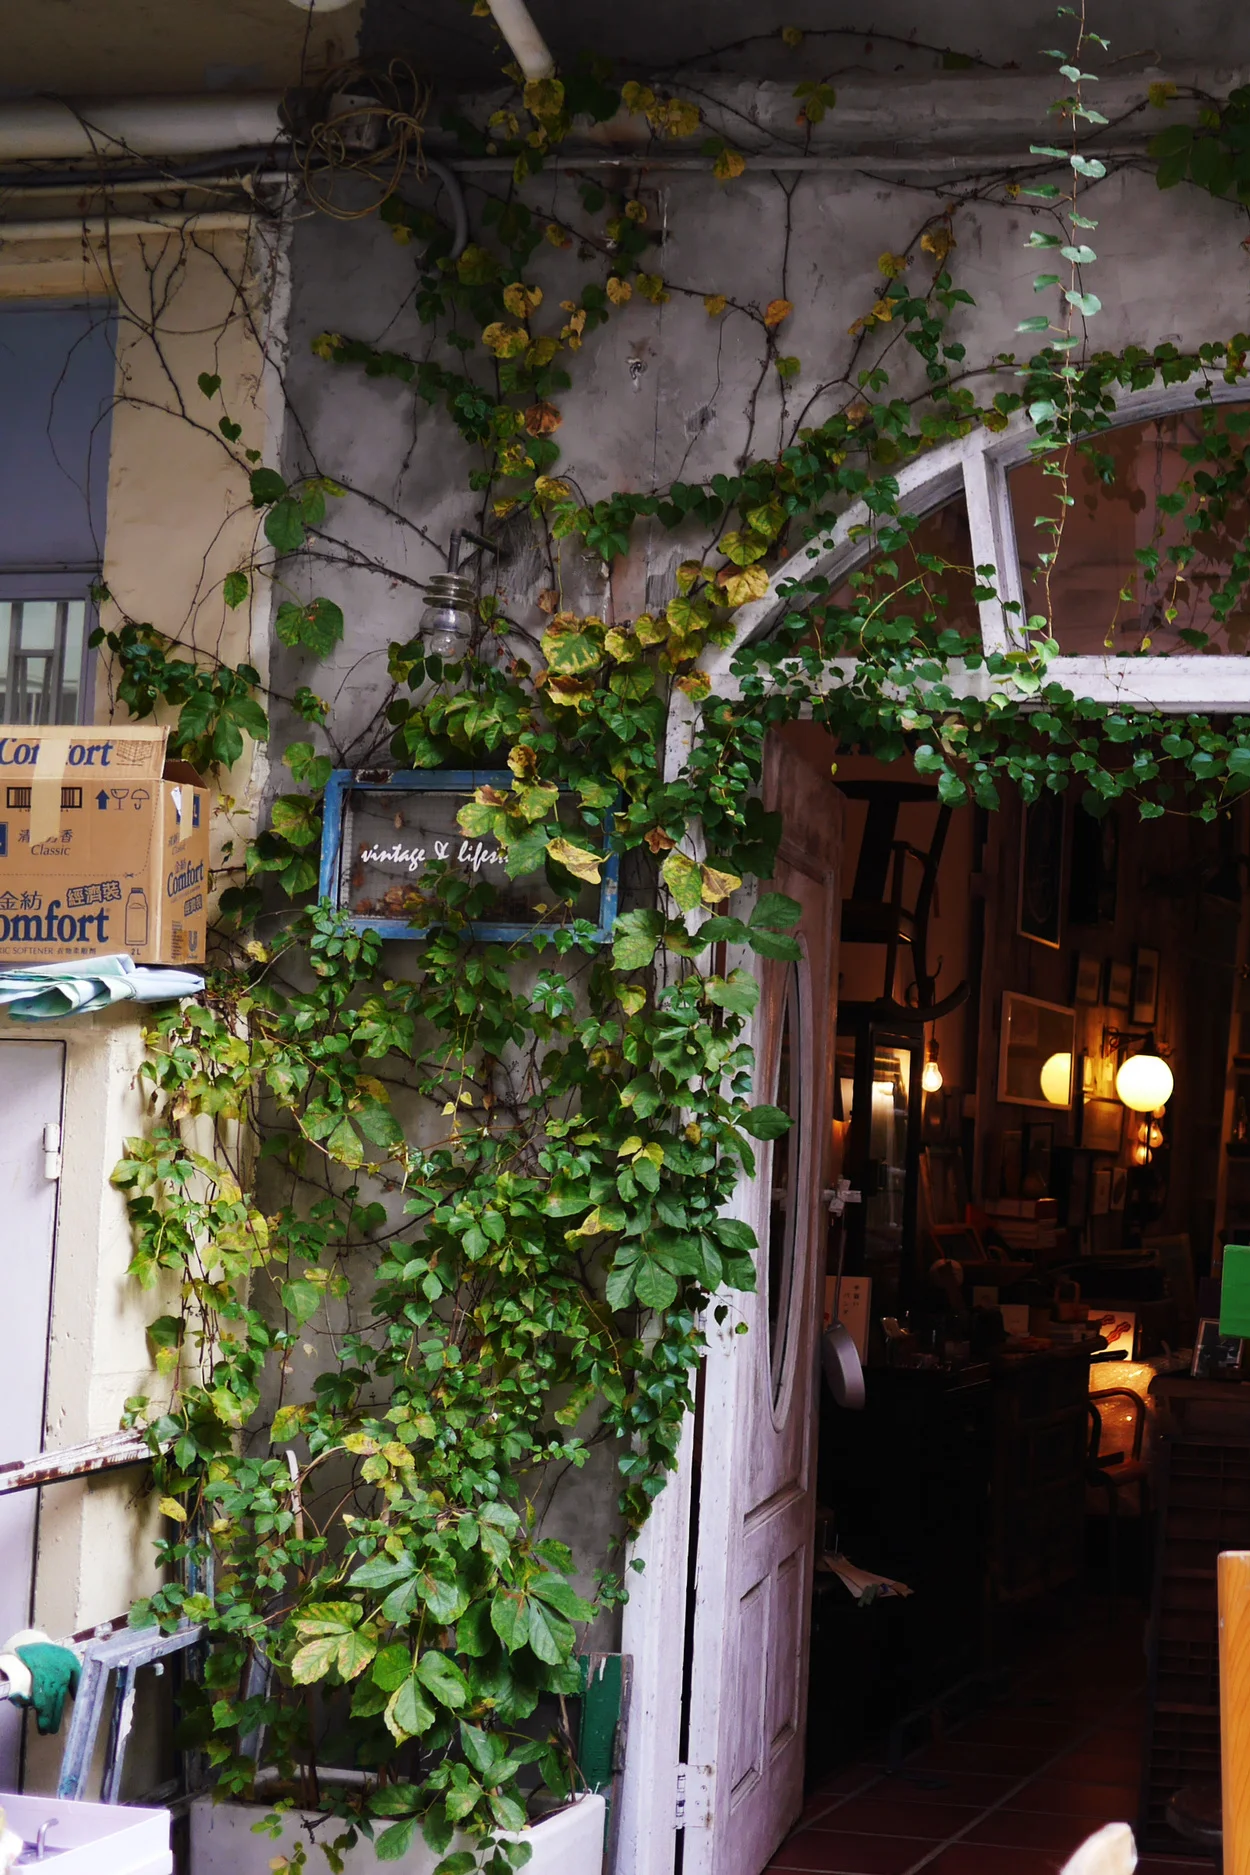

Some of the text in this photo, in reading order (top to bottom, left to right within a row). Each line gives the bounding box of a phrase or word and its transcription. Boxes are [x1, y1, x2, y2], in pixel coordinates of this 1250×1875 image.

[0, 738, 113, 766] Coort
[31, 844, 71, 856] Classic
[361, 840, 509, 871] vintage & lifes
[167, 858, 204, 897] Comfort
[66, 880, 121, 908] 經濟裝
[13, 947, 53, 955] SOFTENER
